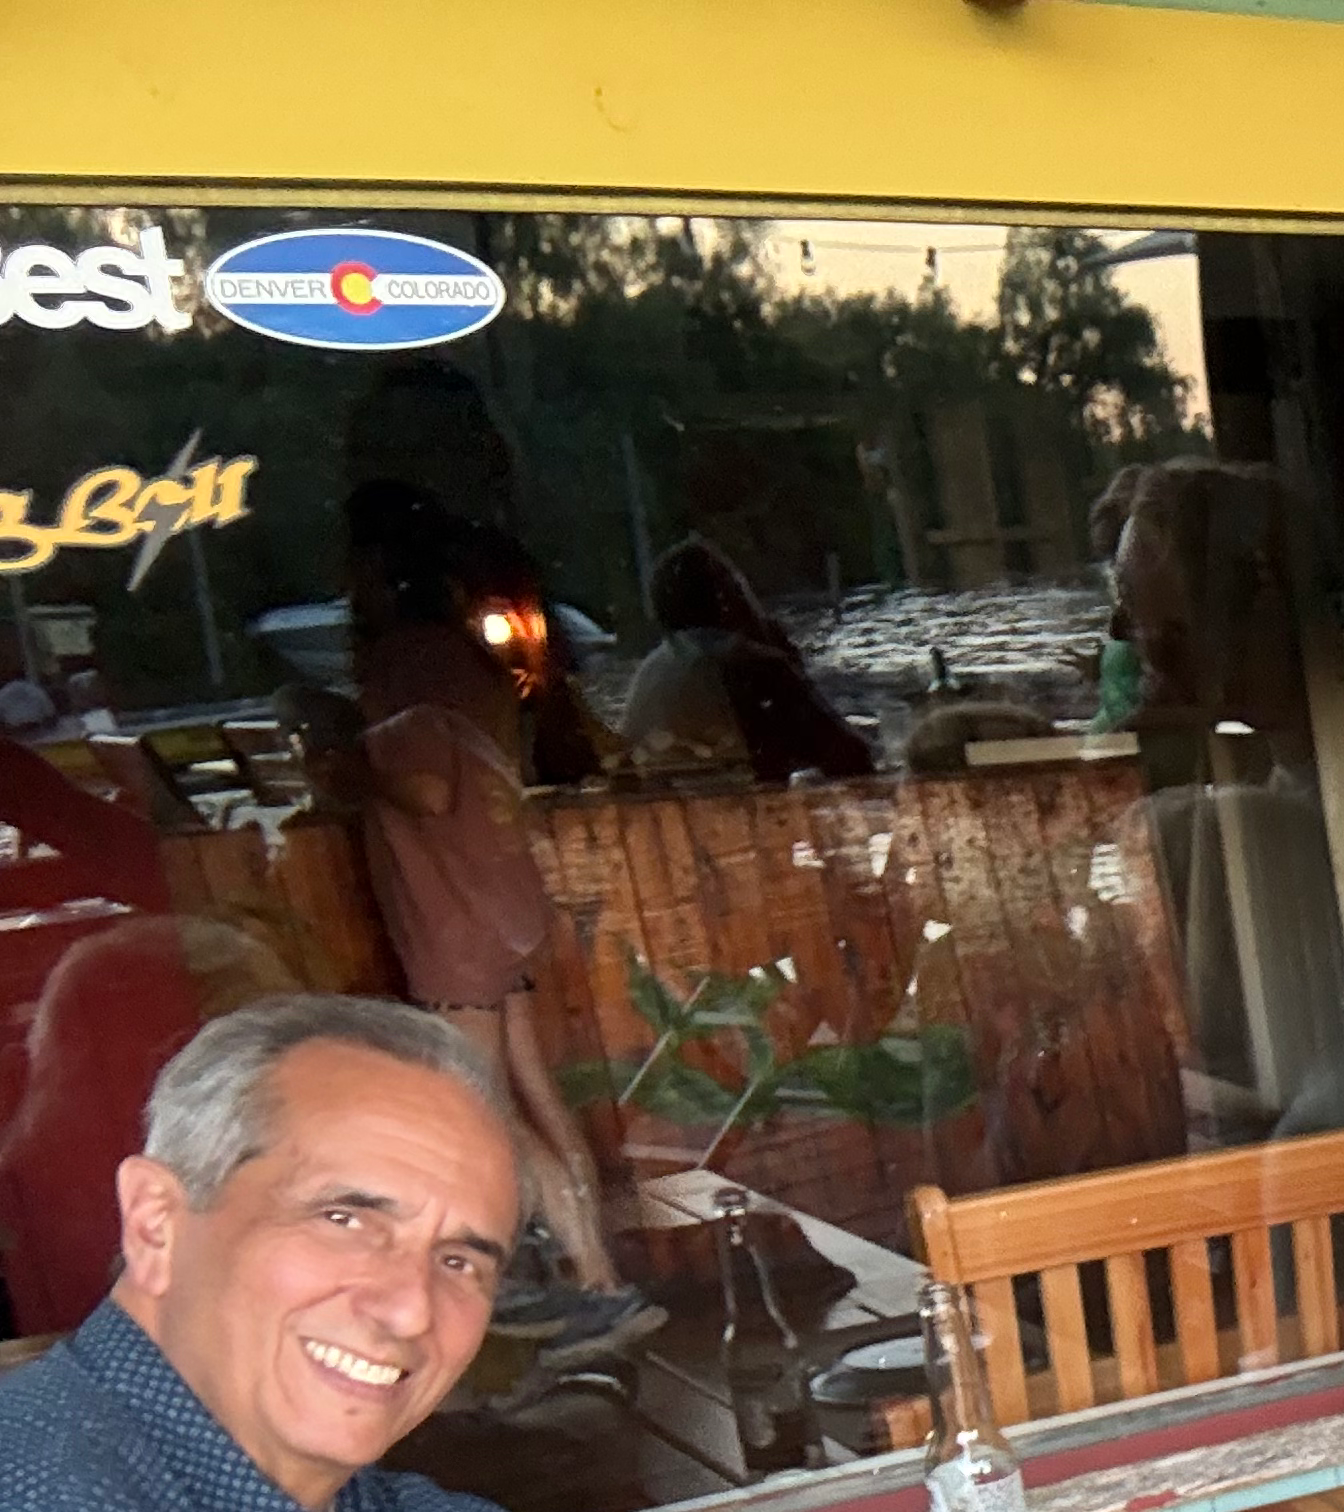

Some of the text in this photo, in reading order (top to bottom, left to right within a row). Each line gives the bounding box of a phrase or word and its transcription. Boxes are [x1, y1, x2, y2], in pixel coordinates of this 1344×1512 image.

[0, 226, 193, 334] est
[220, 279, 326, 299] DENVER
[388, 279, 490, 301] COLORADO
